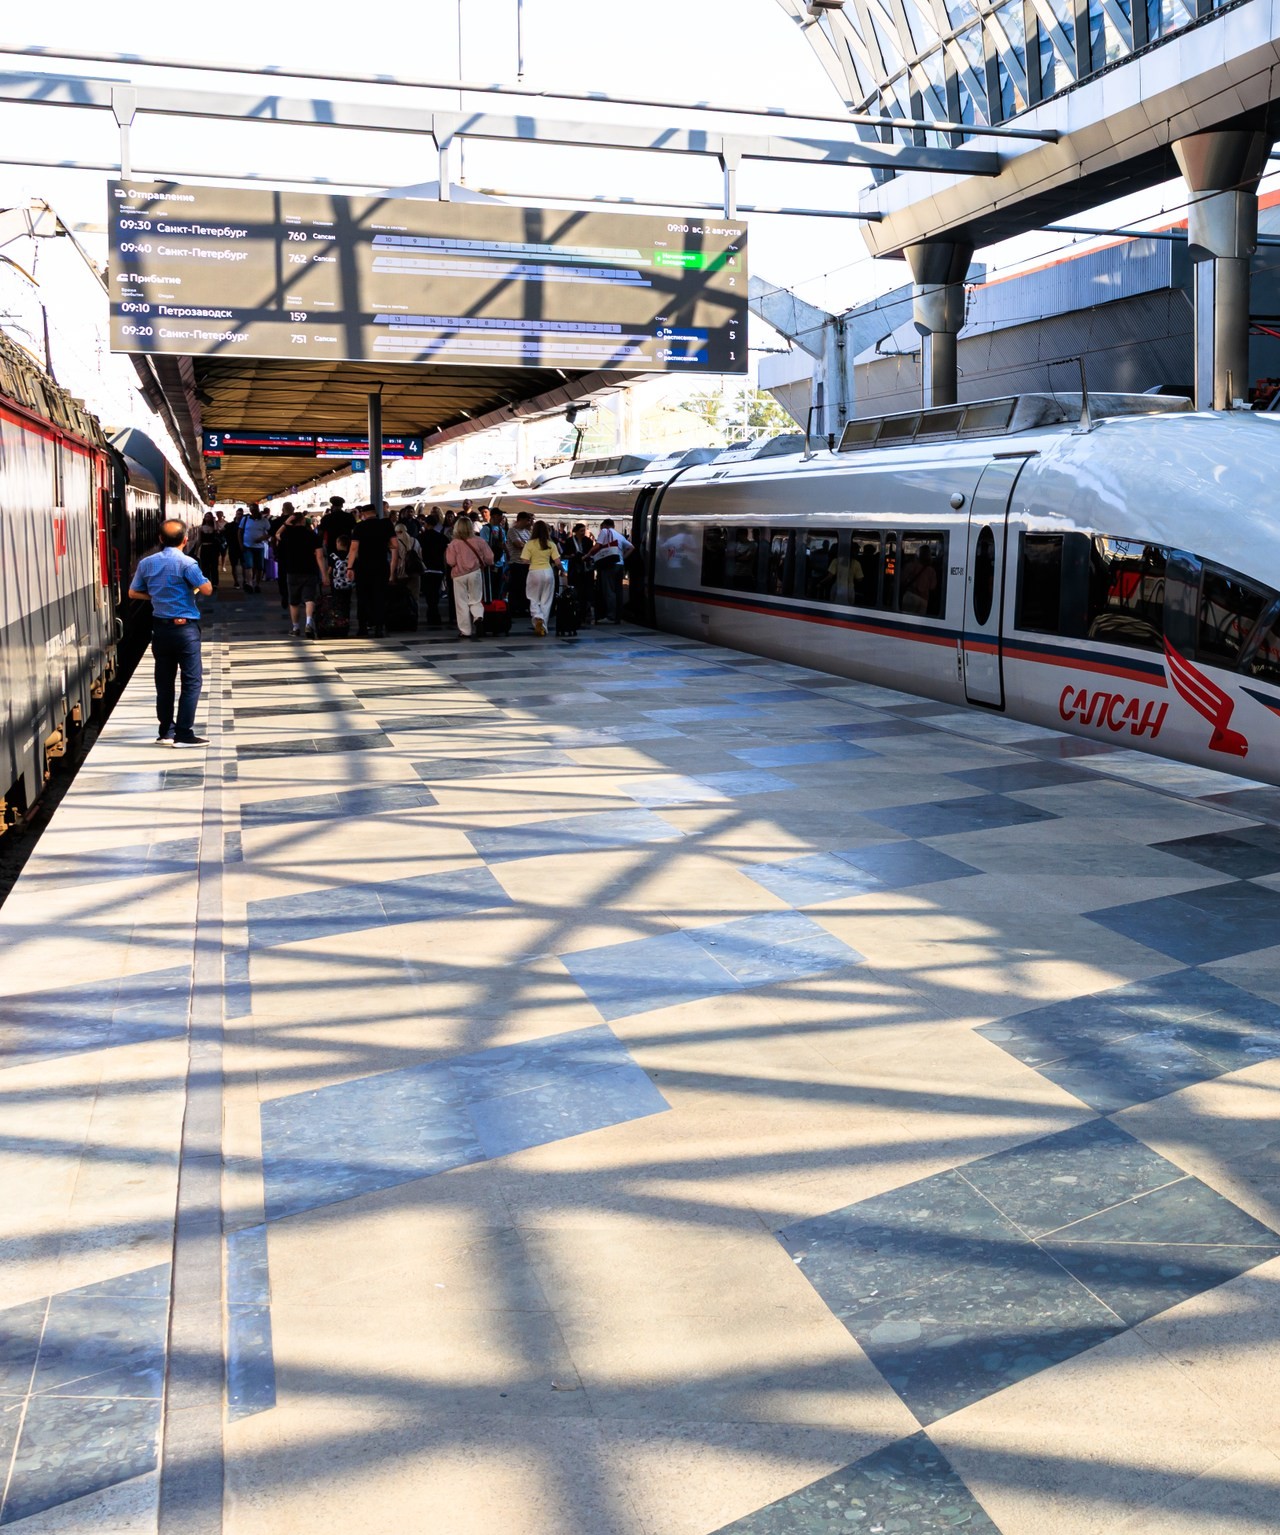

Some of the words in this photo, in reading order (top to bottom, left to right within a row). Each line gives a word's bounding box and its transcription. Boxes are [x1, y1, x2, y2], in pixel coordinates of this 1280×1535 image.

[128, 189, 195, 202] Отправление
[120, 219, 151, 231] 09:30
[156, 222, 248, 239] Санкт-Петербург
[287, 231, 307, 241] 760
[312, 232, 336, 241] Сапсан
[667, 223, 689, 233] 09:10
[705, 226, 711, 234] 2
[711, 227, 742, 236] августа
[120, 242, 152, 254] 09:40
[157, 245, 249, 262] Санкт-Петербург
[288, 253, 307, 264] 762
[313, 255, 337, 263] Сапсан
[728, 256, 736, 265] 4
[129, 273, 182, 285] Прибытие
[729, 277, 736, 286] 2
[121, 302, 150, 313] 09:10
[158, 305, 233, 318] Петрозаводск
[289, 311, 308, 321] 159
[122, 325, 153, 336] 09:20
[158, 328, 249, 343] Санкт-Петербург
[290, 334, 307, 344] 751
[314, 335, 337, 343] Сапсан
[729, 331, 736, 340] 5
[729, 351, 736, 361] 1
[209, 434, 218, 447] 3
[409, 440, 418, 452] 4
[1058, 684, 1169, 739] САПСАН
